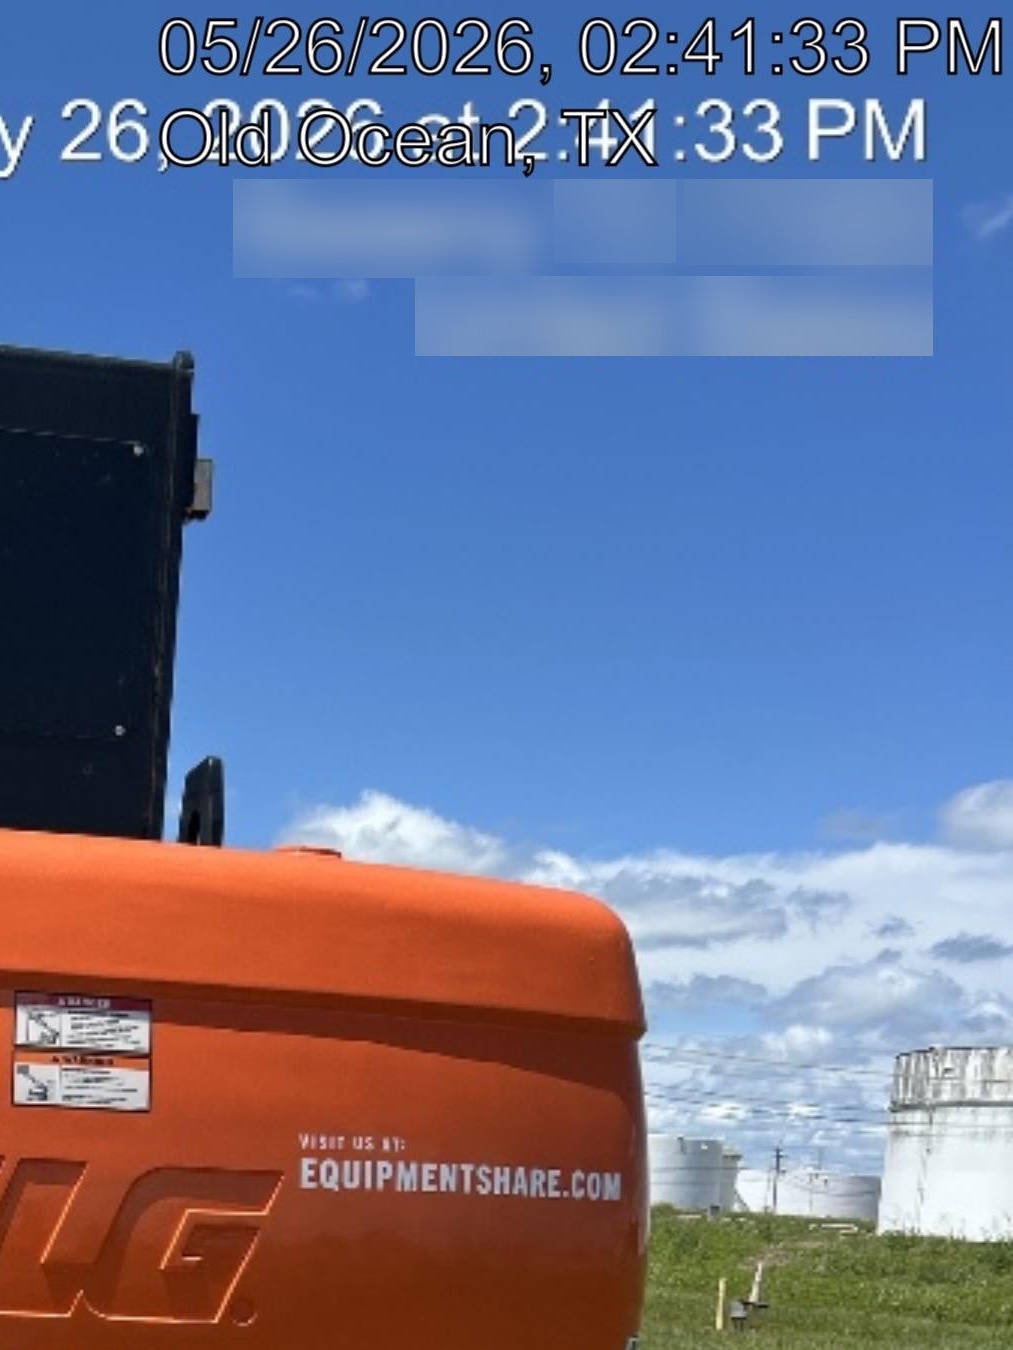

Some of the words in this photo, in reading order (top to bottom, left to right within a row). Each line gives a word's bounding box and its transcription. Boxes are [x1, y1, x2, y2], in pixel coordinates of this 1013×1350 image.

[298, 1132, 345, 1151] VISIT
[352, 1134, 376, 1151] US
[299, 1157, 622, 1200] EQUIPMENTSHARE.COM
